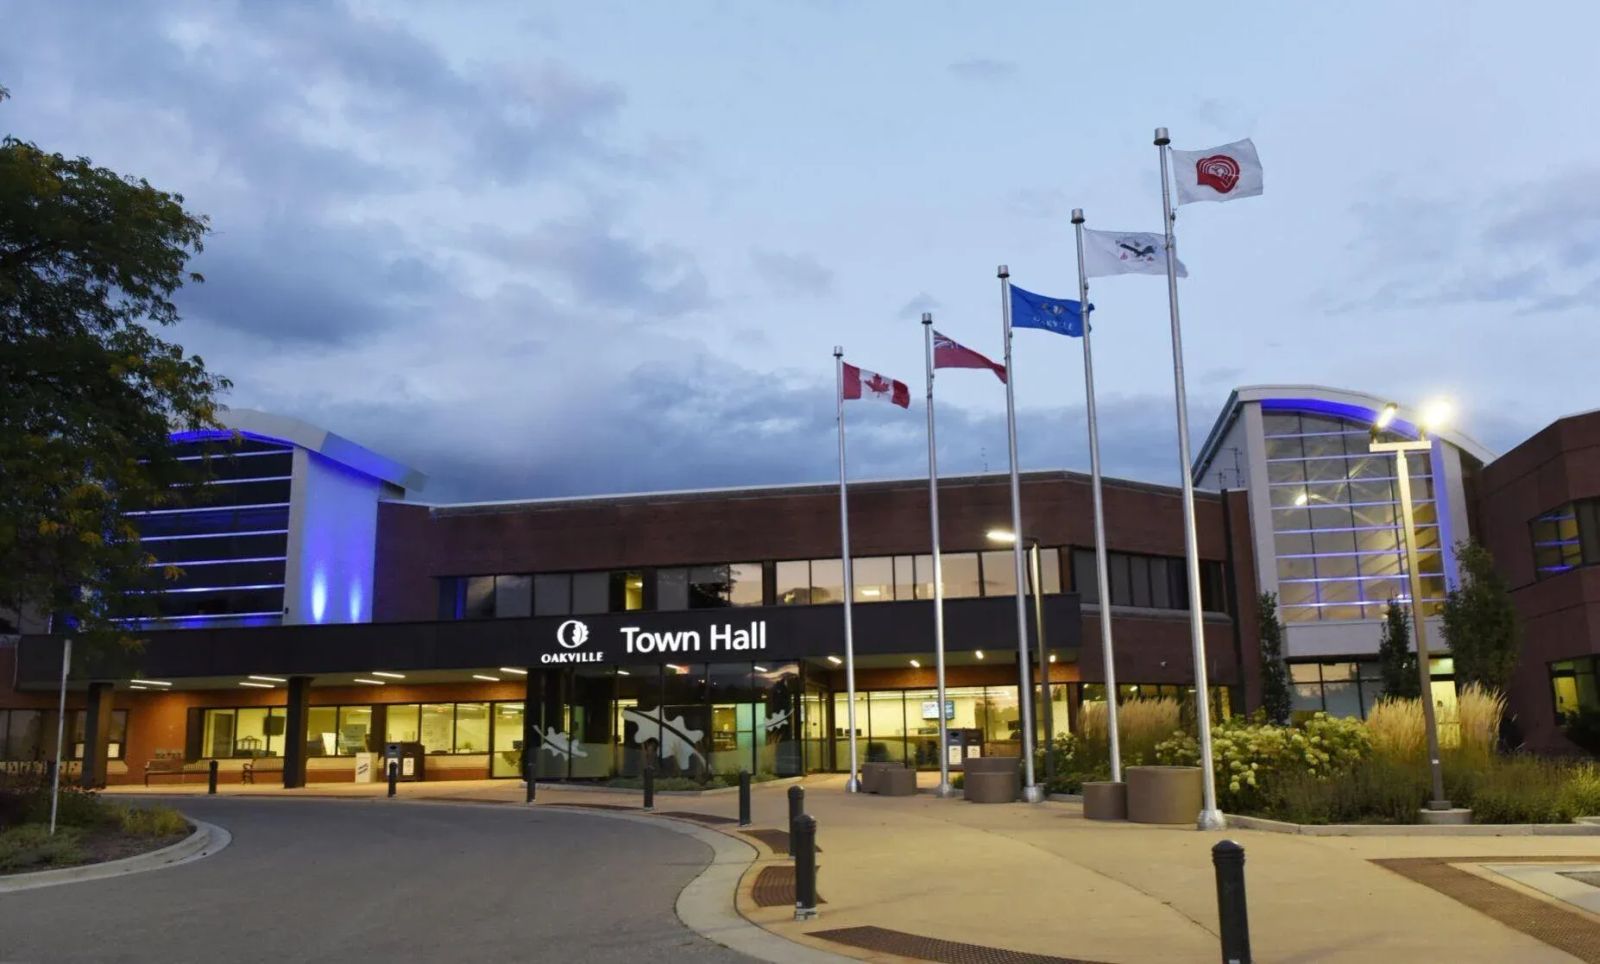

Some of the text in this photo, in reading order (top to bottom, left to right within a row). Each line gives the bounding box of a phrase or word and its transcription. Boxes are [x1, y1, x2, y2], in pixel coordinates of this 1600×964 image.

[620, 620, 766, 653] Town Hall
[541, 651, 604, 664] OAKVILLE
